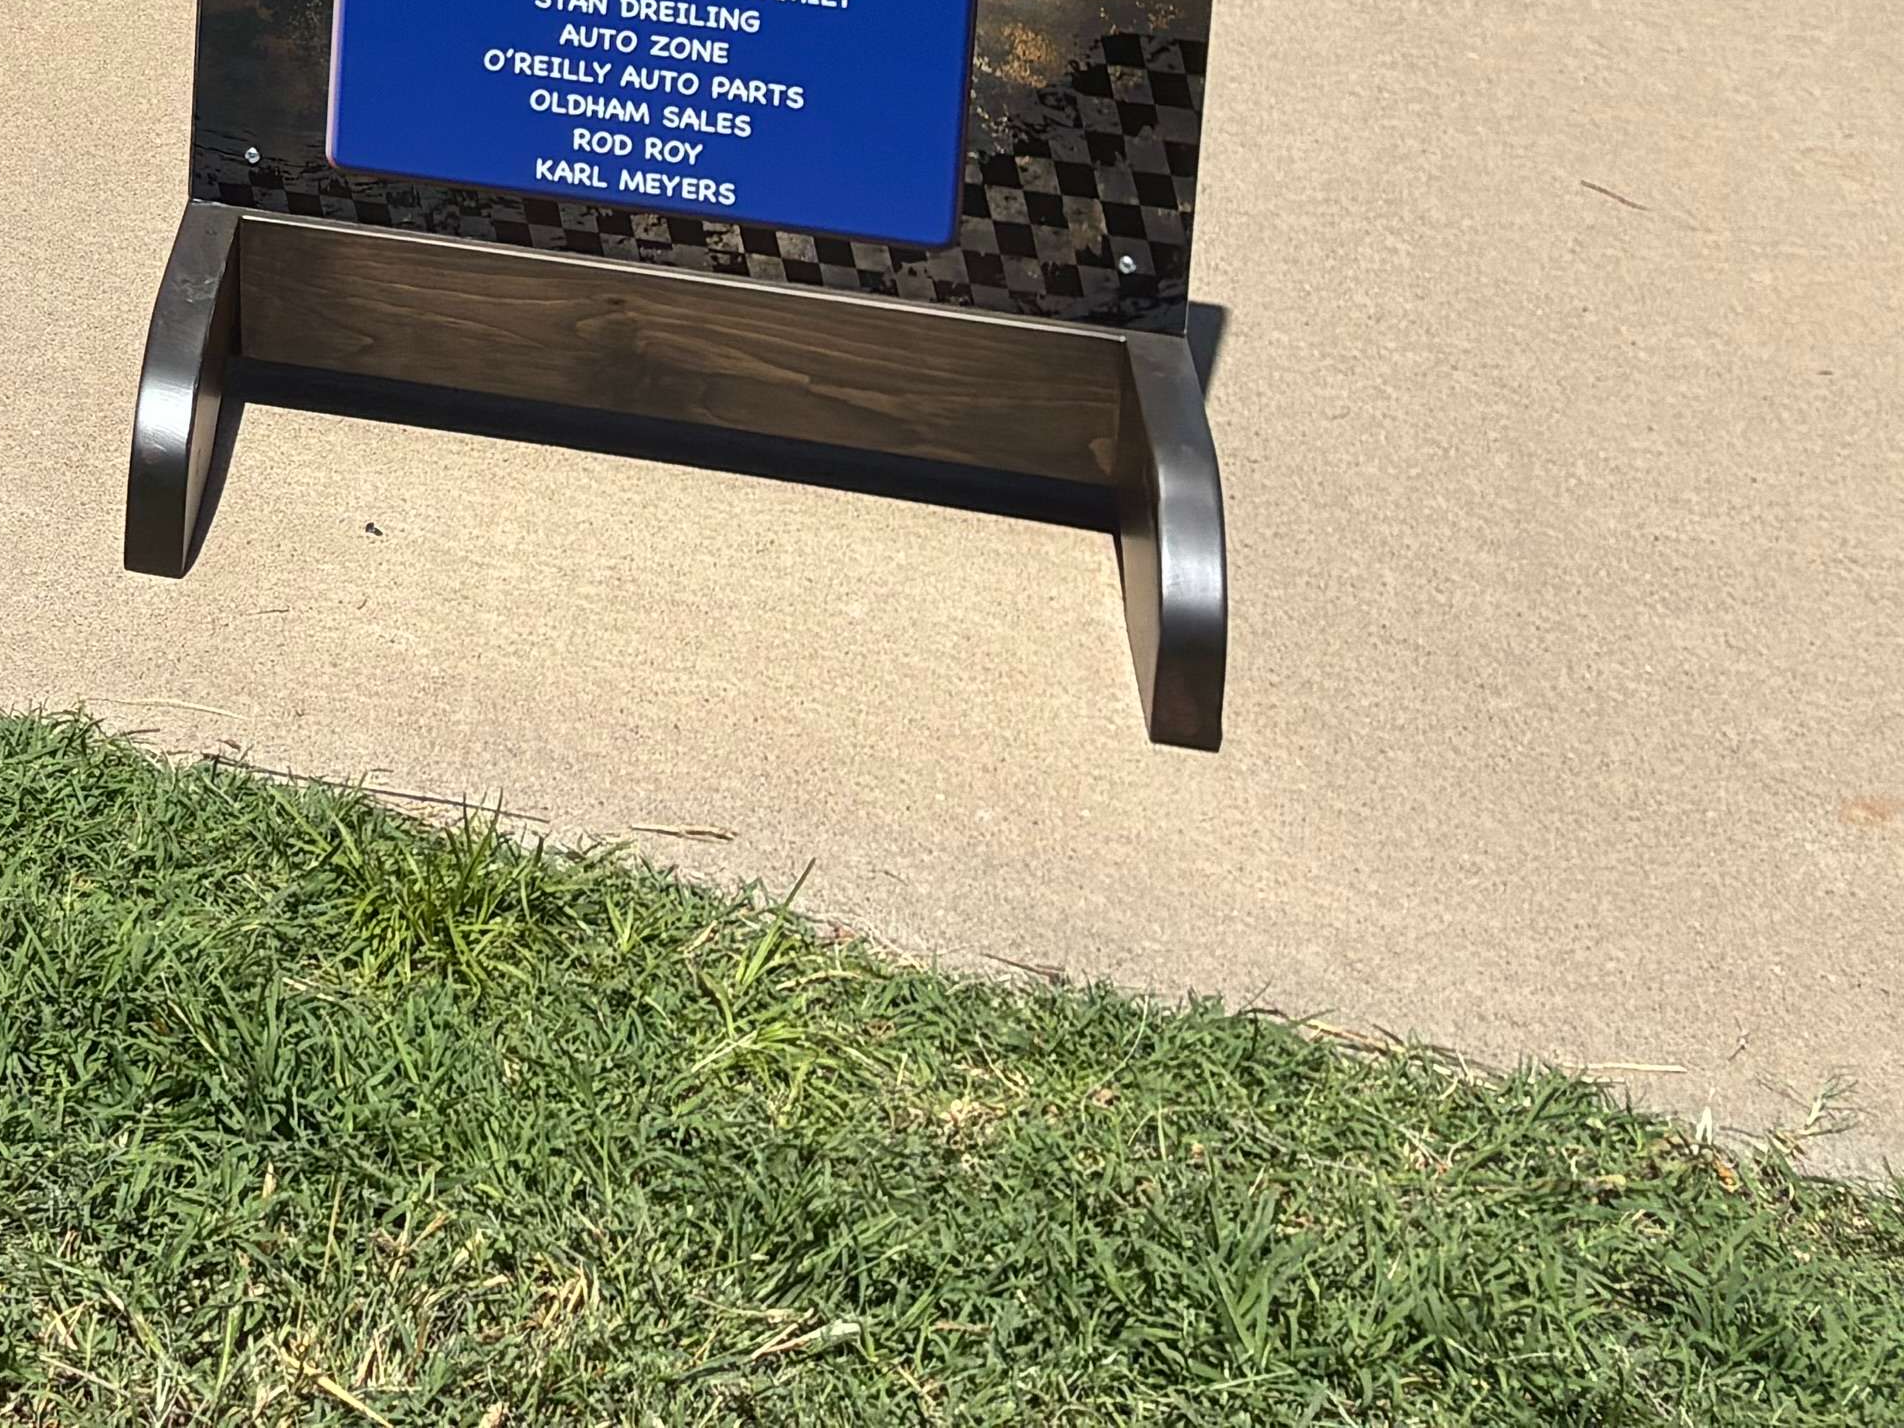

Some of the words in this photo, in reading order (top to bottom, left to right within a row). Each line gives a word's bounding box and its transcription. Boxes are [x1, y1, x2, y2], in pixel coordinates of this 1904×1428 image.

[559, 23, 638, 54] AUTO
[650, 35, 730, 65] ZONE
[483, 49, 611, 86] O'REILLY
[620, 66, 700, 97] AUTO
[711, 80, 806, 110] PARTS
[529, 89, 651, 126] OLDHAM
[662, 106, 753, 138] SALES
[572, 128, 634, 156] ROD
[645, 137, 704, 166] ROY
[535, 158, 608, 189] KARL
[619, 171, 738, 206] MEYERS
